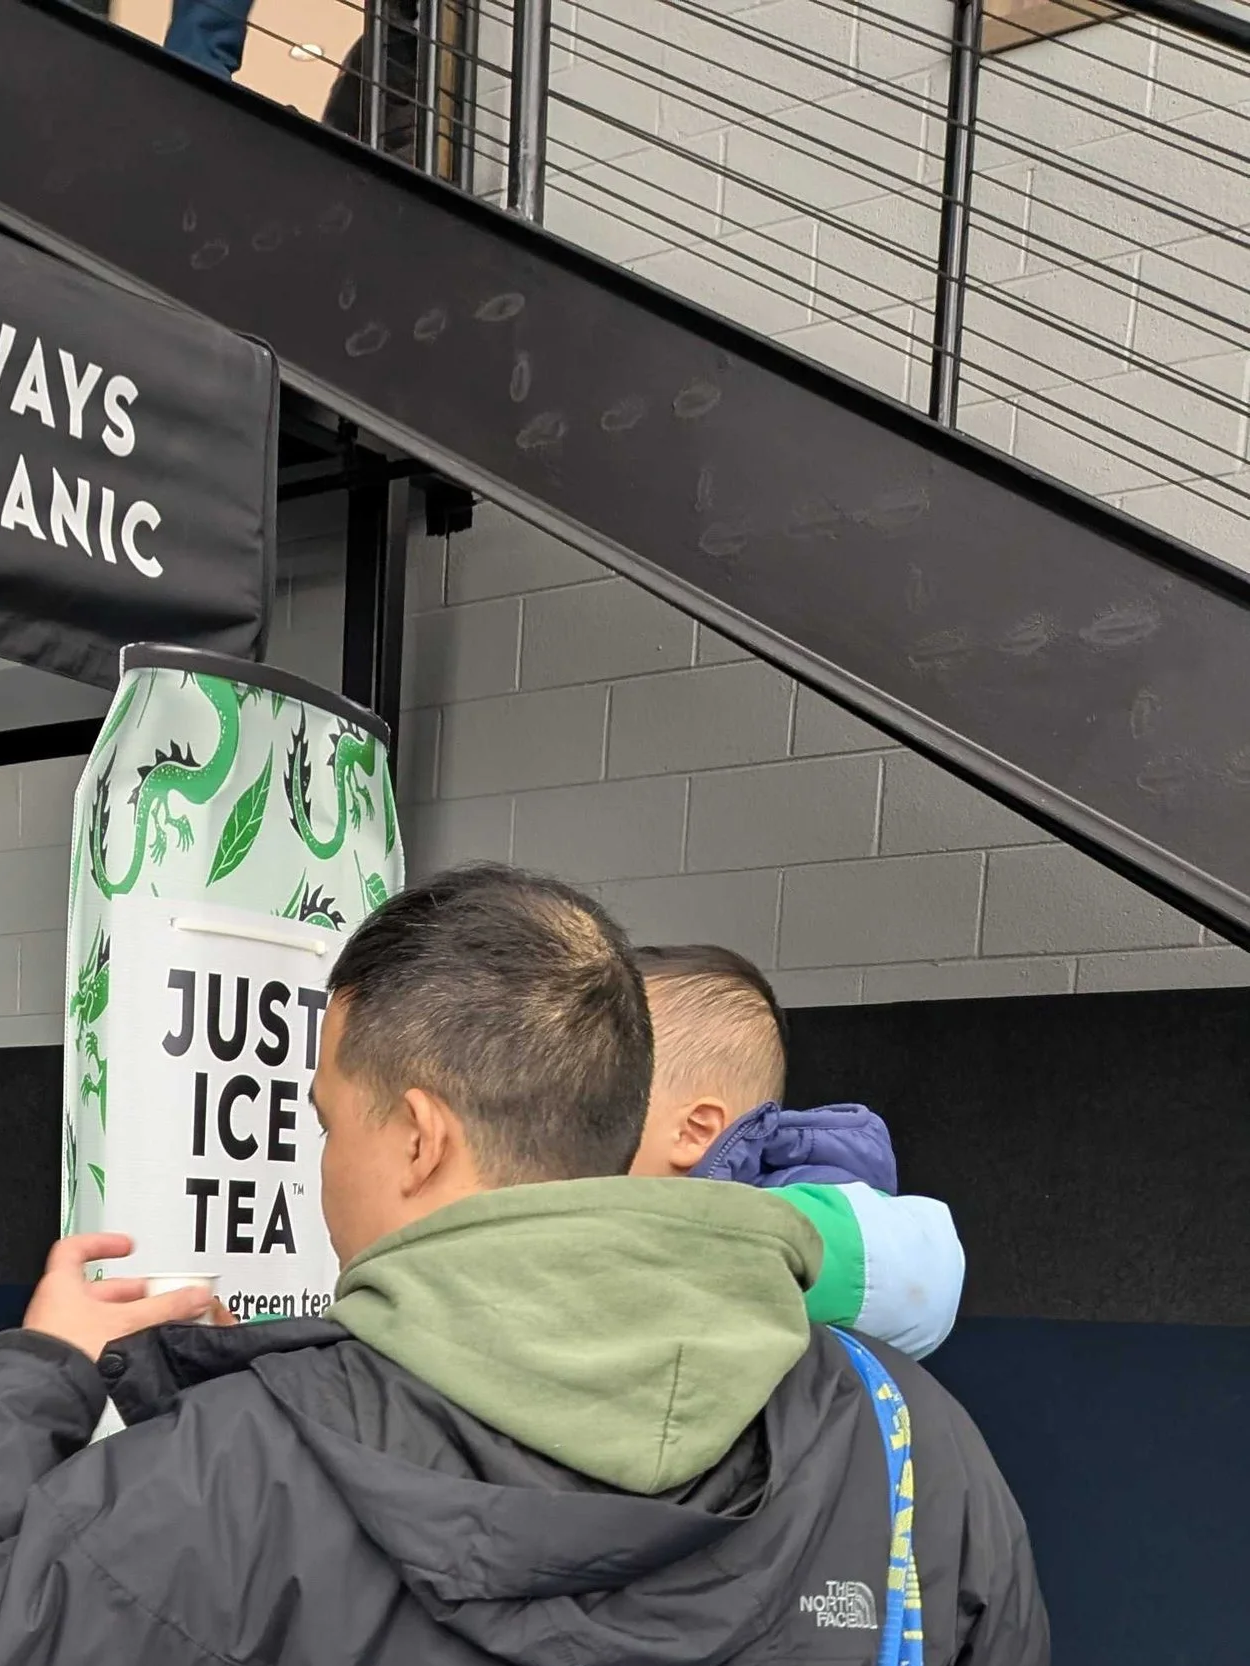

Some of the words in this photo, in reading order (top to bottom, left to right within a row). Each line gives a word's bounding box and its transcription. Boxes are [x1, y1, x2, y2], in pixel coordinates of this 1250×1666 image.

[161, 968, 330, 1070] JUST
[191, 1072, 299, 1162] ICE
[228, 1289, 296, 1323] green
[825, 1580, 856, 1597] THE
[799, 1595, 854, 1612] NORTH
[816, 1612, 859, 1628] FACE
